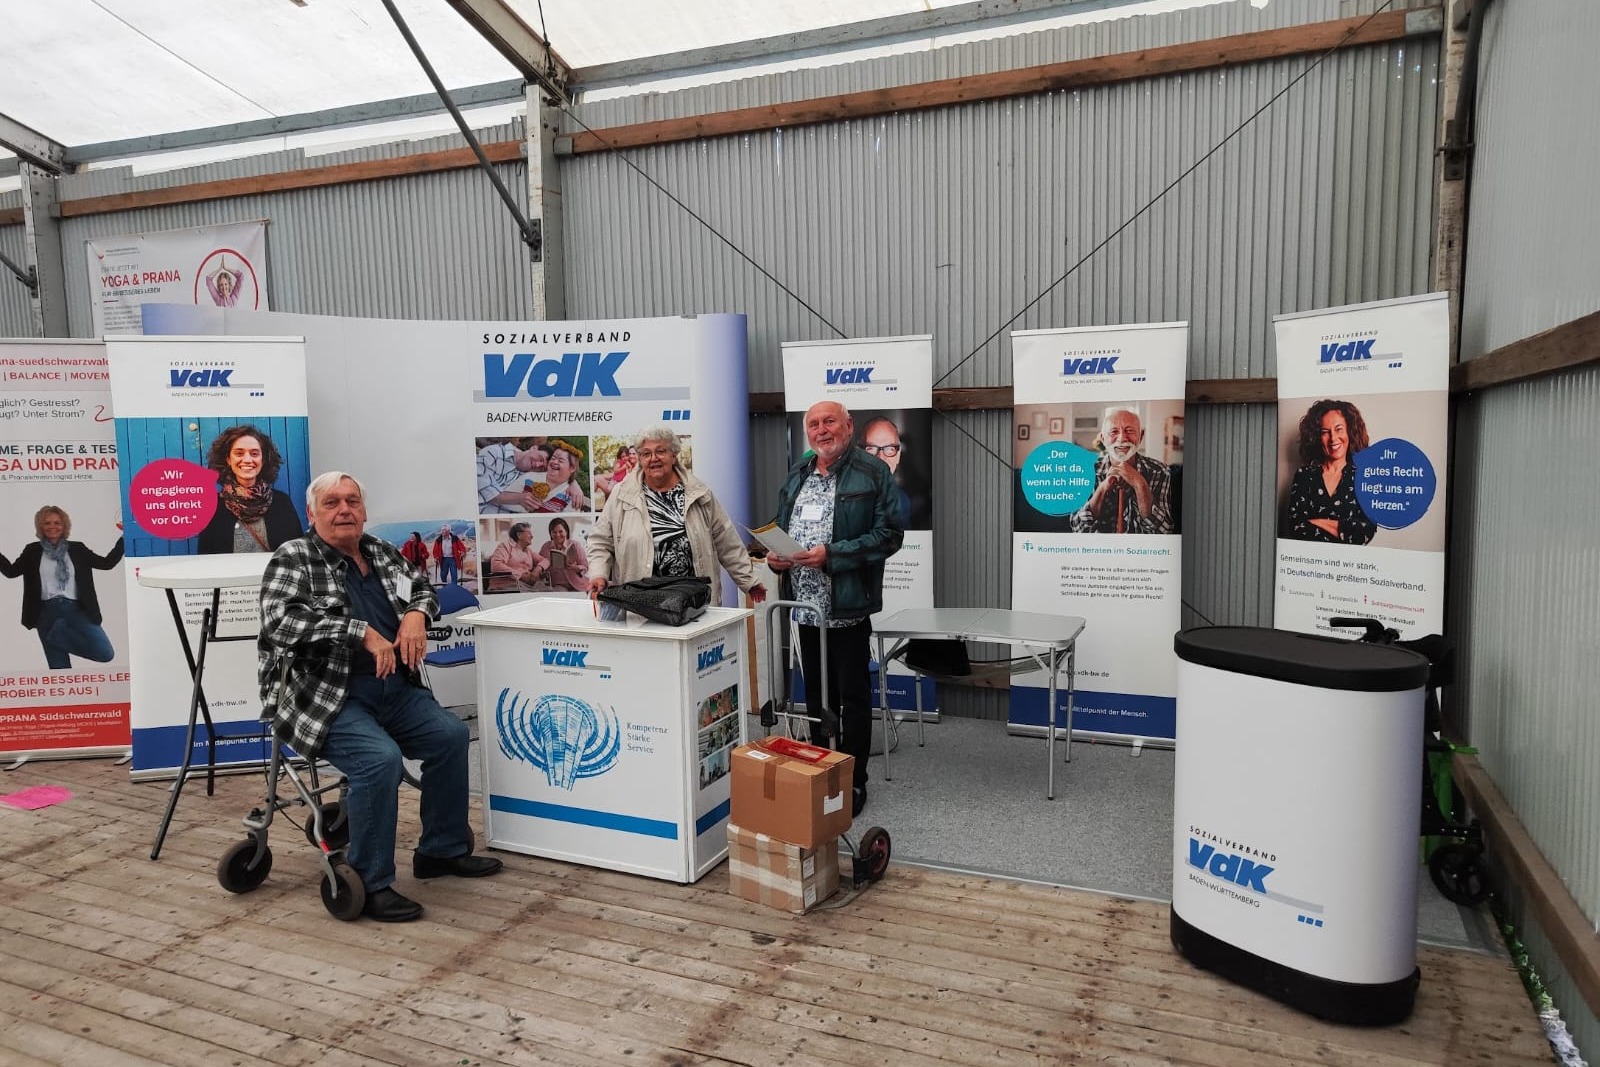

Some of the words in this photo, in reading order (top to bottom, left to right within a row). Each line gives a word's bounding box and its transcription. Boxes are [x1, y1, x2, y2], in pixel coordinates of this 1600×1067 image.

[101, 274, 129, 288] YOGA
[133, 273, 140, 285] &
[143, 269, 181, 284] PRANA
[483, 331, 631, 344] SOZIALVERBAND
[1320, 339, 1376, 363] VdK
[1063, 356, 1119, 375] VdK
[10, 372, 61, 380] BALANCE
[170, 369, 234, 387] VdK
[483, 352, 631, 398] VdK
[826, 367, 873, 384] VdK
[29, 398, 80, 407] Gestresst?
[23, 409, 47, 418] Unter
[51, 409, 85, 418] Strom?
[486, 409, 613, 423] BADEN-WÜRTTEMBERG
[27, 444, 74, 454] FRAGE
[79, 444, 88, 454] &
[91, 444, 117, 454] TES
[28, 458, 67, 471] UND
[1034, 463, 1053, 472] VdK
[1055, 463, 1067, 472] ist
[1069, 463, 1084, 473] da,
[1363, 466, 1390, 478] gutes
[1393, 466, 1424, 478] Recht
[1053, 477, 1067, 486] ich
[1069, 477, 1090, 486] Hilfe
[141, 485, 204, 498] engagieren
[1361, 482, 1383, 495] liegt
[1385, 485, 1402, 494] uns
[1404, 486, 1424, 495] am
[145, 501, 166, 510] uns
[168, 499, 202, 510] direkt
[151, 516, 169, 524] vor
[1038, 545, 1080, 555] Kompetent
[1081, 546, 1112, 554] beraten
[1126, 547, 1173, 556] Sozialrecht.
[1280, 554, 1323, 565] Gemeinsam
[1324, 559, 1341, 567] sind
[1342, 560, 1355, 568] wir
[1356, 562, 1379, 572] stark,
[1287, 567, 1335, 580] Deutschlands
[1370, 576, 1426, 592] Sozialverband.
[542, 648, 588, 667] VdK
[698, 643, 725, 670] VdK
[20, 676, 38, 686] EIN
[42, 674, 105, 685] BESSERES
[50, 687, 65, 696] ES
[69, 686, 93, 696] AUS
[0, 713, 37, 723] PRANA
[39, 709, 122, 721] Südschwarzwald
[1109, 708, 1120, 716] der
[1121, 709, 1149, 718] Mensch.
[627, 721, 668, 733] Kompetenz
[627, 743, 654, 754] Service
[1189, 826, 1277, 862] SOZIALVERBAND
[1189, 837, 1275, 894] VdK
[1189, 873, 1261, 908] BADEN-WÜRTTEMBERG
